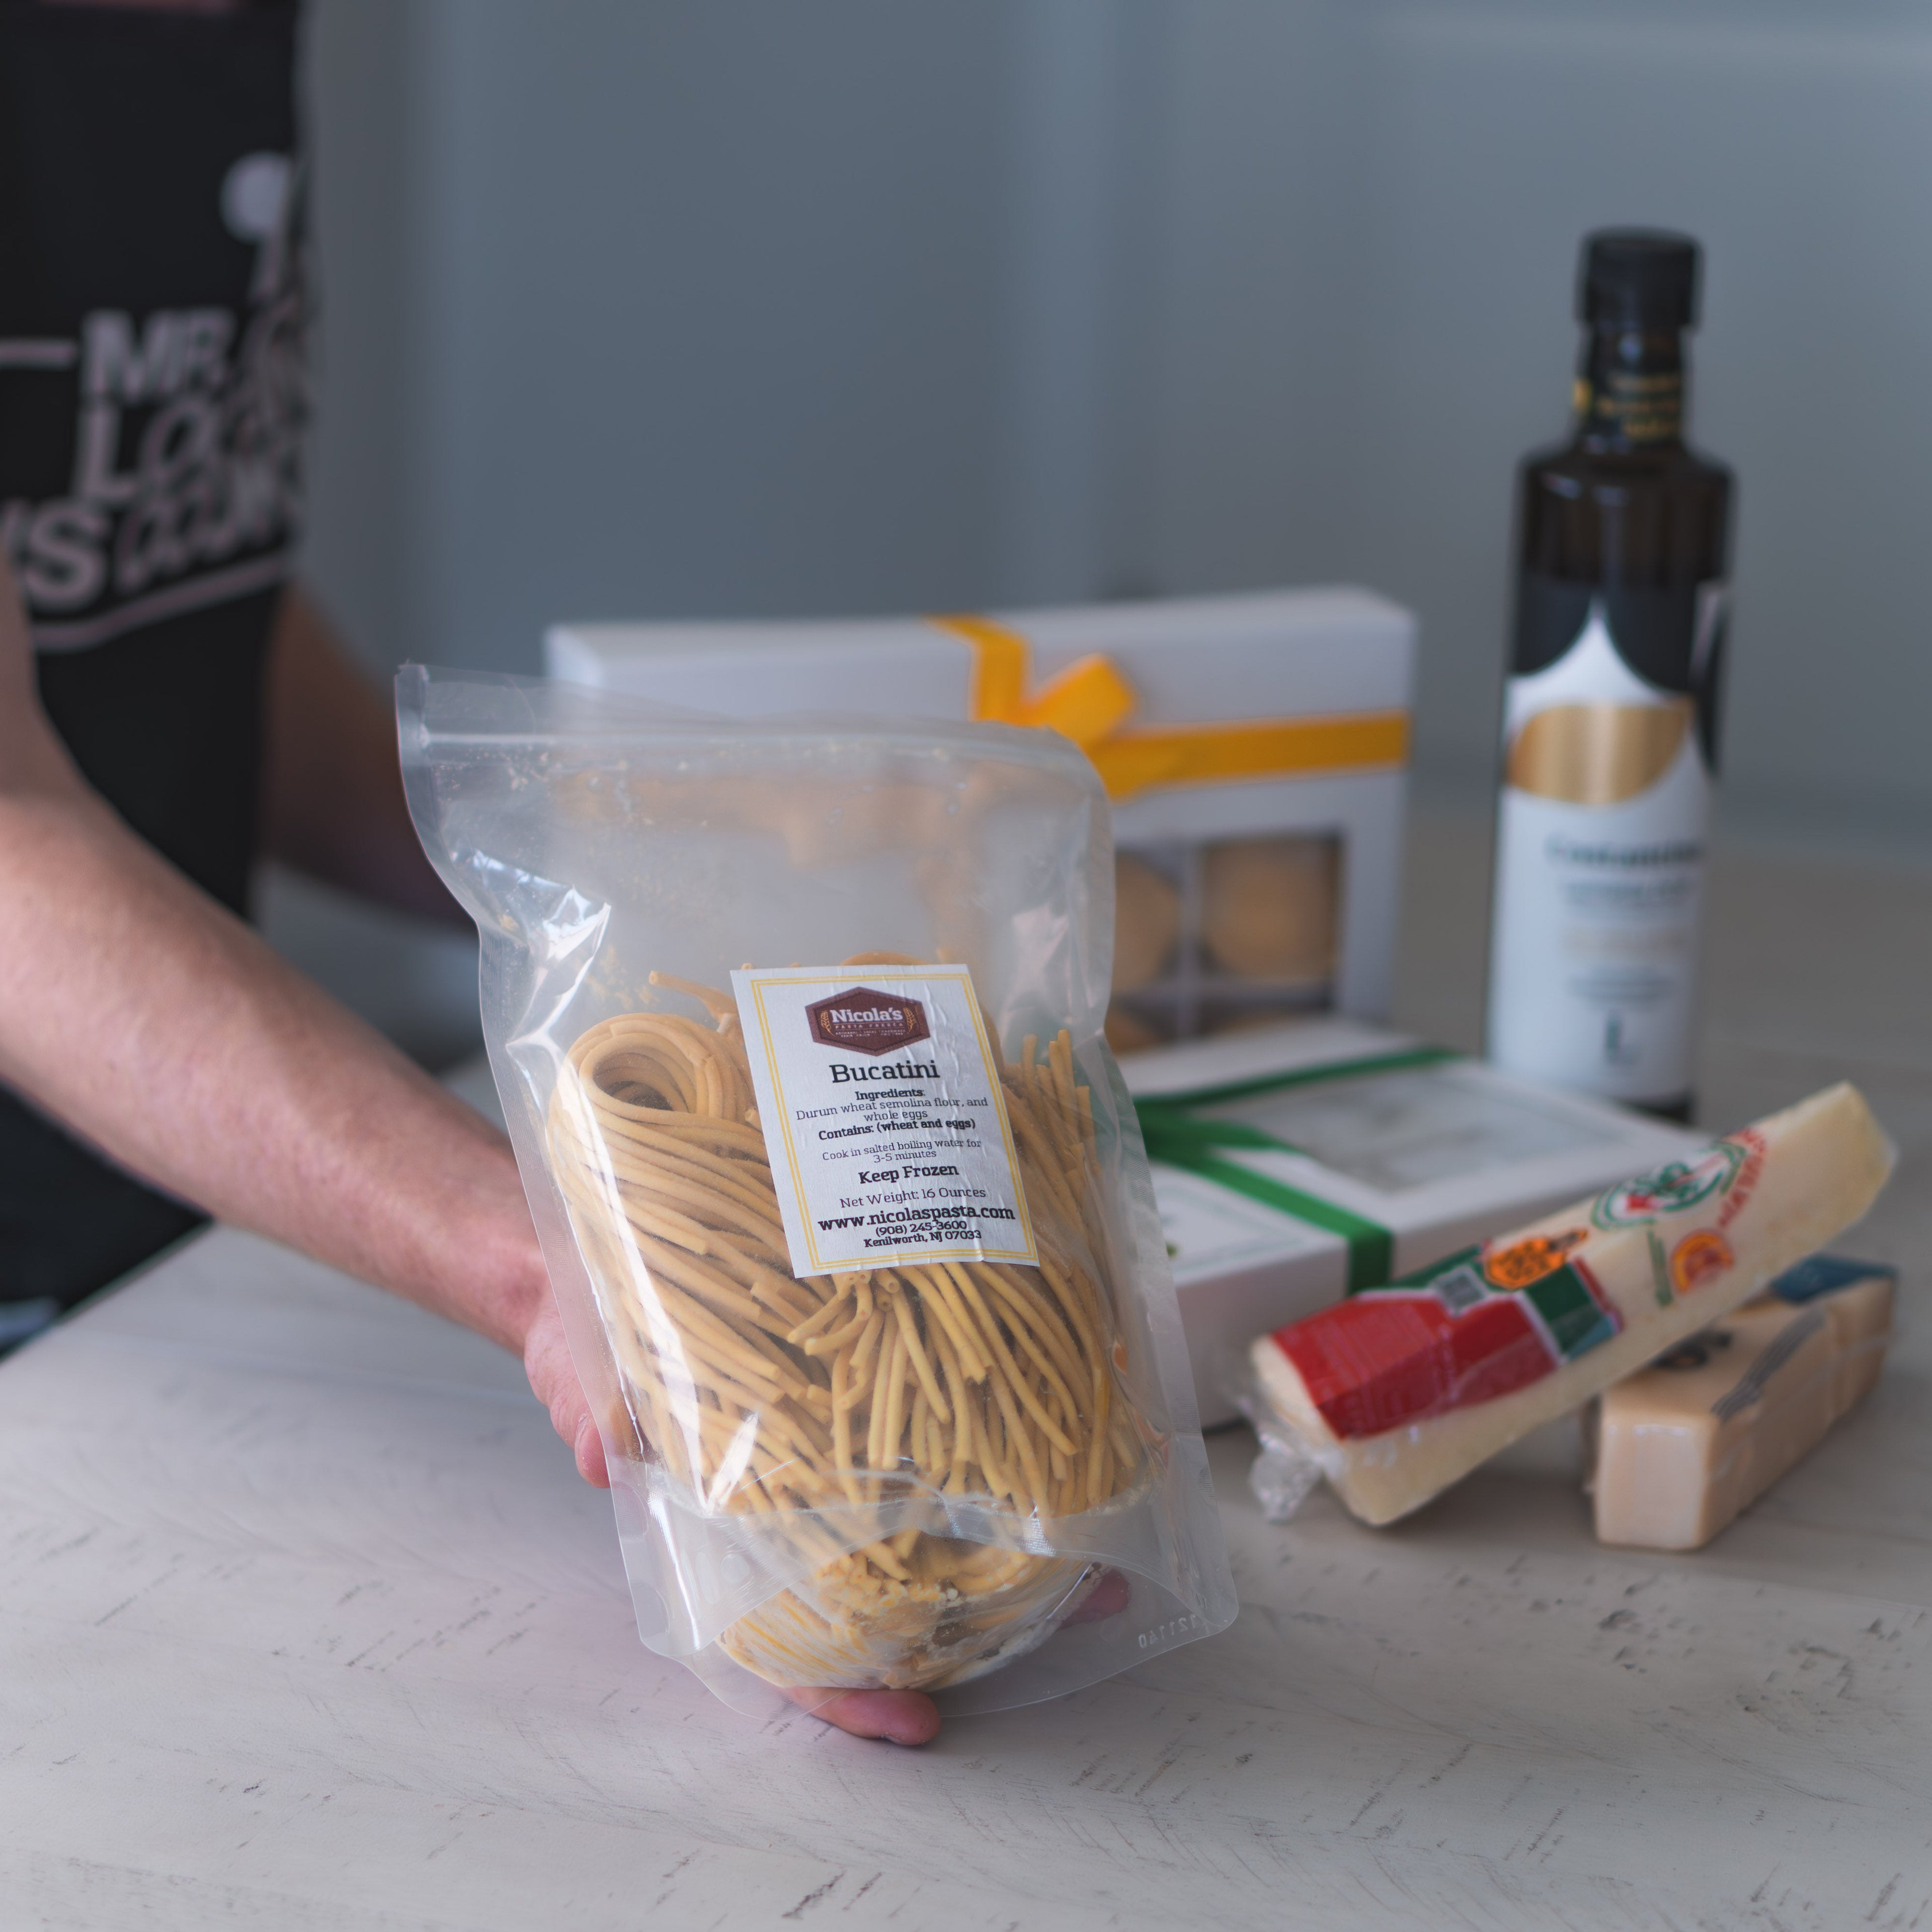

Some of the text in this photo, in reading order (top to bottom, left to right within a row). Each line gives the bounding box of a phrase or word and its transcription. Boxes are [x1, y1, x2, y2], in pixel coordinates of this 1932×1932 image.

[830, 1007, 903, 1023] Nicola's
[829, 1060, 940, 1083] Bucatini
[855, 1089, 925, 1101] Ingredients:
[796, 1097, 988, 1120] Durum wheat semolina flour, and
[864, 1109, 928, 1121] whole eggs
[819, 1118, 976, 1140] Contains: (wheat and eggs)
[822, 1139, 982, 1160] Cook in salted boiling water for
[874, 1150, 937, 1163] 3-5 minutes
[858, 1165, 959, 1184] Keep Frozen
[840, 1187, 986, 1208] Net Weight: 16 Ounces
[818, 1205, 1016, 1231] www.nicolaspasta.com
[876, 1220, 968, 1237] (908) 245-3600
[864, 1230, 982, 1248] Kenilworth, NJ 07033
